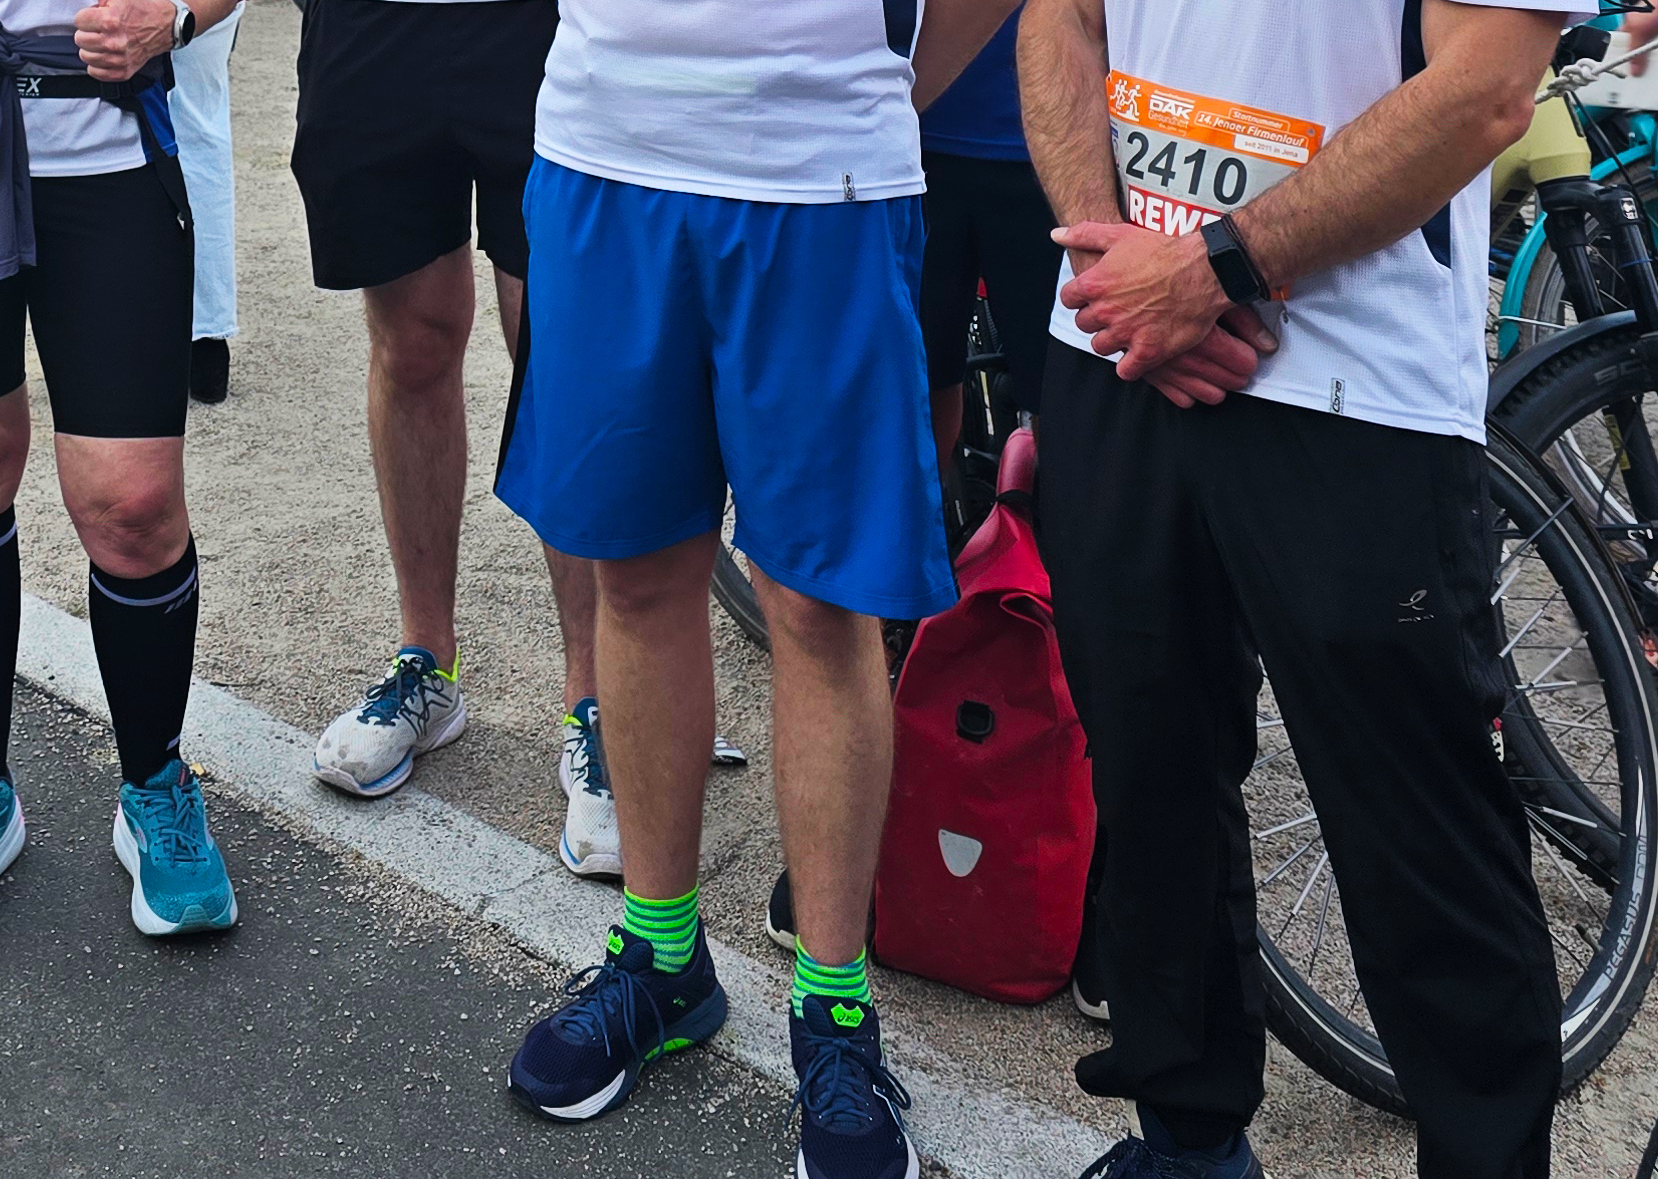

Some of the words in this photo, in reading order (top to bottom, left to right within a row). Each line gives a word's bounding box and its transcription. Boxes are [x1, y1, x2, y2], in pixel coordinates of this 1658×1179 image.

[1149, 98, 1193, 120] DAK
[1232, 111, 1283, 129] Startnummer
[1198, 114, 1212, 125] 14.
[1212, 117, 1246, 133] Jenaer
[1247, 125, 1304, 147] Firmenlauf
[1125, 131, 1247, 206] 2410
[1605, 891, 1642, 981] PEGASUS
